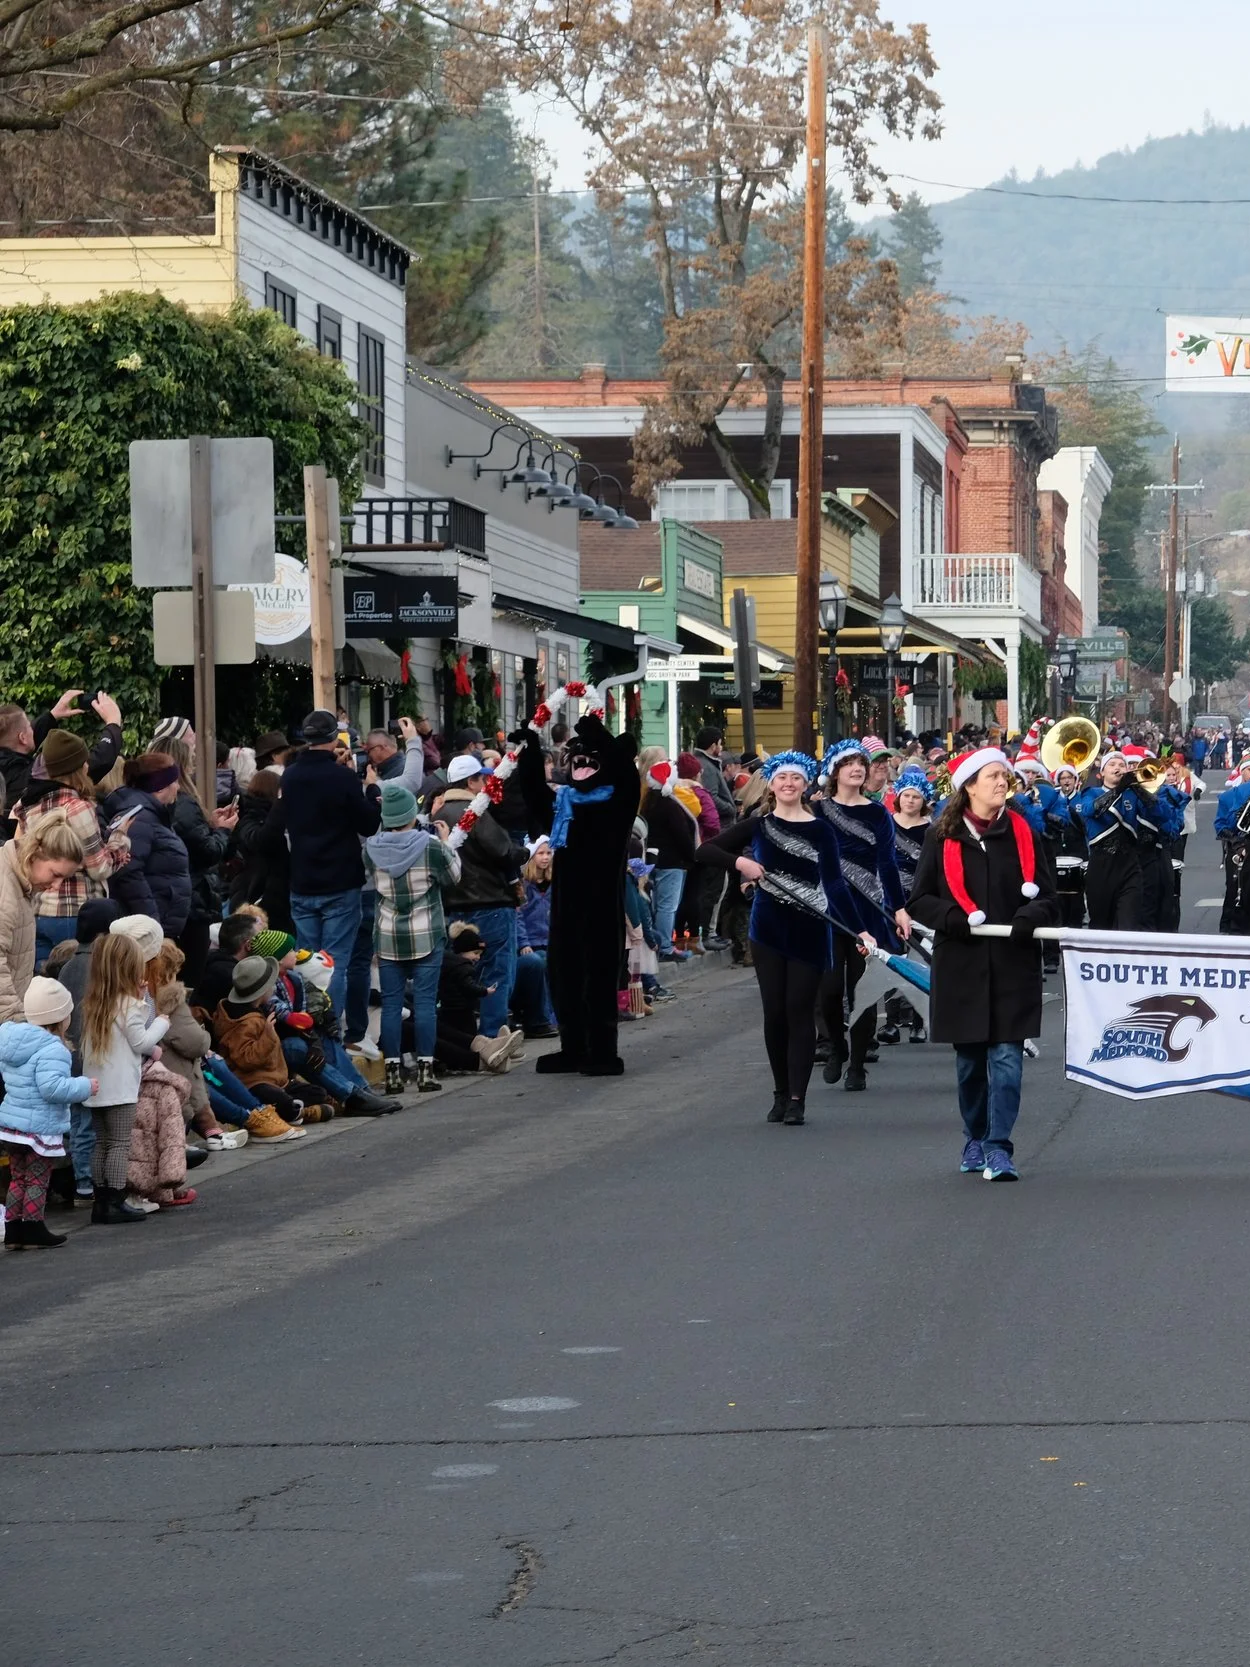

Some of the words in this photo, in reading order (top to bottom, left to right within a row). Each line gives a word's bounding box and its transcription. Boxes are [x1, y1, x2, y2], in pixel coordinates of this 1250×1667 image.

[240, 586, 309, 602] AKERY
[344, 612, 358, 620] pert
[359, 611, 393, 620] Properties
[399, 609, 456, 617] JACKSONVILLE
[863, 665, 883, 680] LOCK
[1080, 962, 1168, 986] SOUTH
[1101, 1028, 1163, 1048] SOUTH
[1087, 1044, 1169, 1065] MEDFORD
